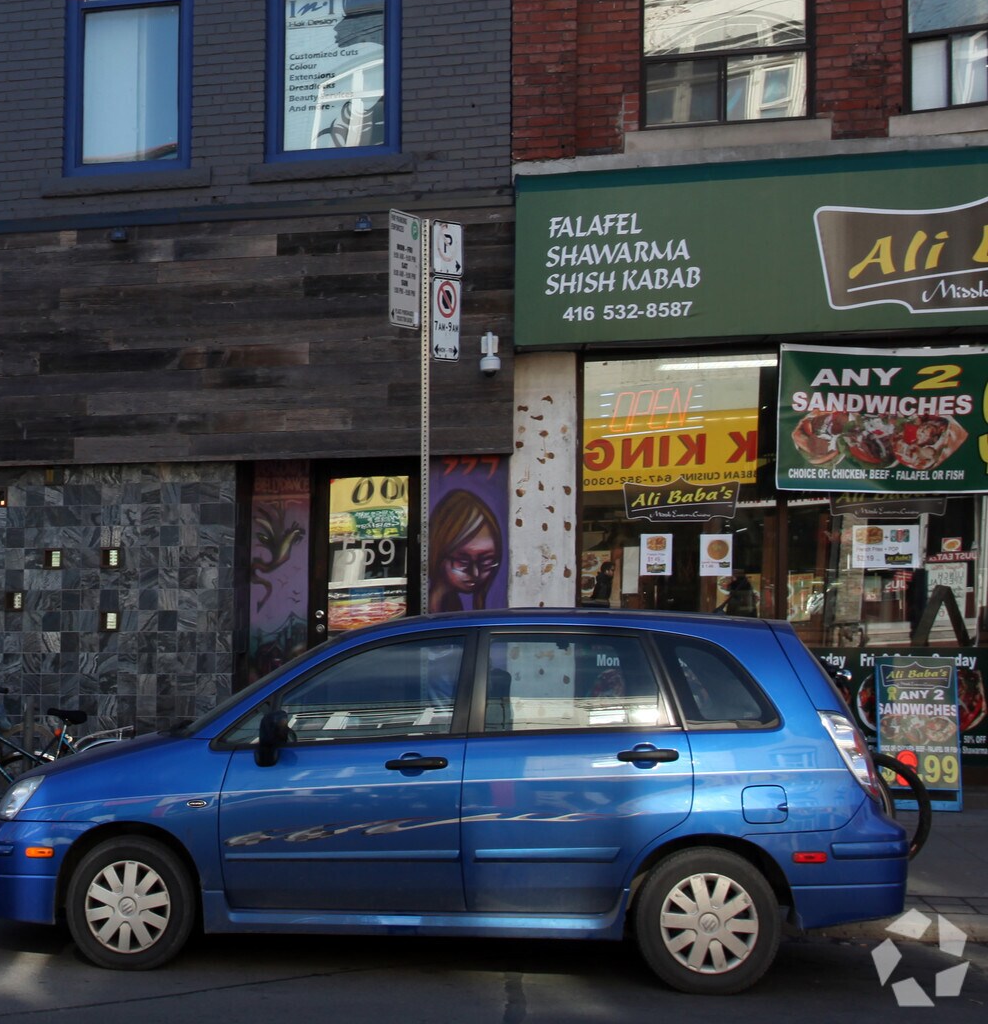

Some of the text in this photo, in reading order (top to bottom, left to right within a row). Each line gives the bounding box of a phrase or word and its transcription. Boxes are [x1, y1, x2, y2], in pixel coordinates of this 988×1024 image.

[289, 49, 359, 61] Customized Cuts
[289, 63, 318, 71] Colour
[289, 72, 336, 82] Extensions
[289, 94, 318, 102] Beauty
[289, 104, 307, 113] And
[549, 212, 643, 238] FALAFEL
[545, 238, 691, 268] SHAWARMA
[848, 230, 950, 280] Ali
[545, 266, 702, 296] SHISH KABAB
[562, 301, 693, 322] 416 532-8587
[810, 364, 963, 390] ANY 2
[609, 386, 693, 433] OPEN
[791, 391, 973, 416] SANDWICHES
[788, 468, 816, 479] CHOICE
[817, 468, 831, 479] OF:
[869, 469, 891, 480] BEEF
[896, 470, 930, 481] FALAFEL
[932, 470, 944, 480] OR
[944, 470, 965, 480] FISH
[631, 492, 662, 508] Ali
[667, 486, 734, 504] Baba's
[340, 538, 396, 566] 559
[596, 654, 621, 666] Mon
[860, 653, 875, 667] Fri
[886, 668, 948, 679] Ali Baba's
[899, 689, 945, 700] ANY 2
[879, 702, 957, 716] SANDWICHES
[975, 735, 987, 744] OFF
